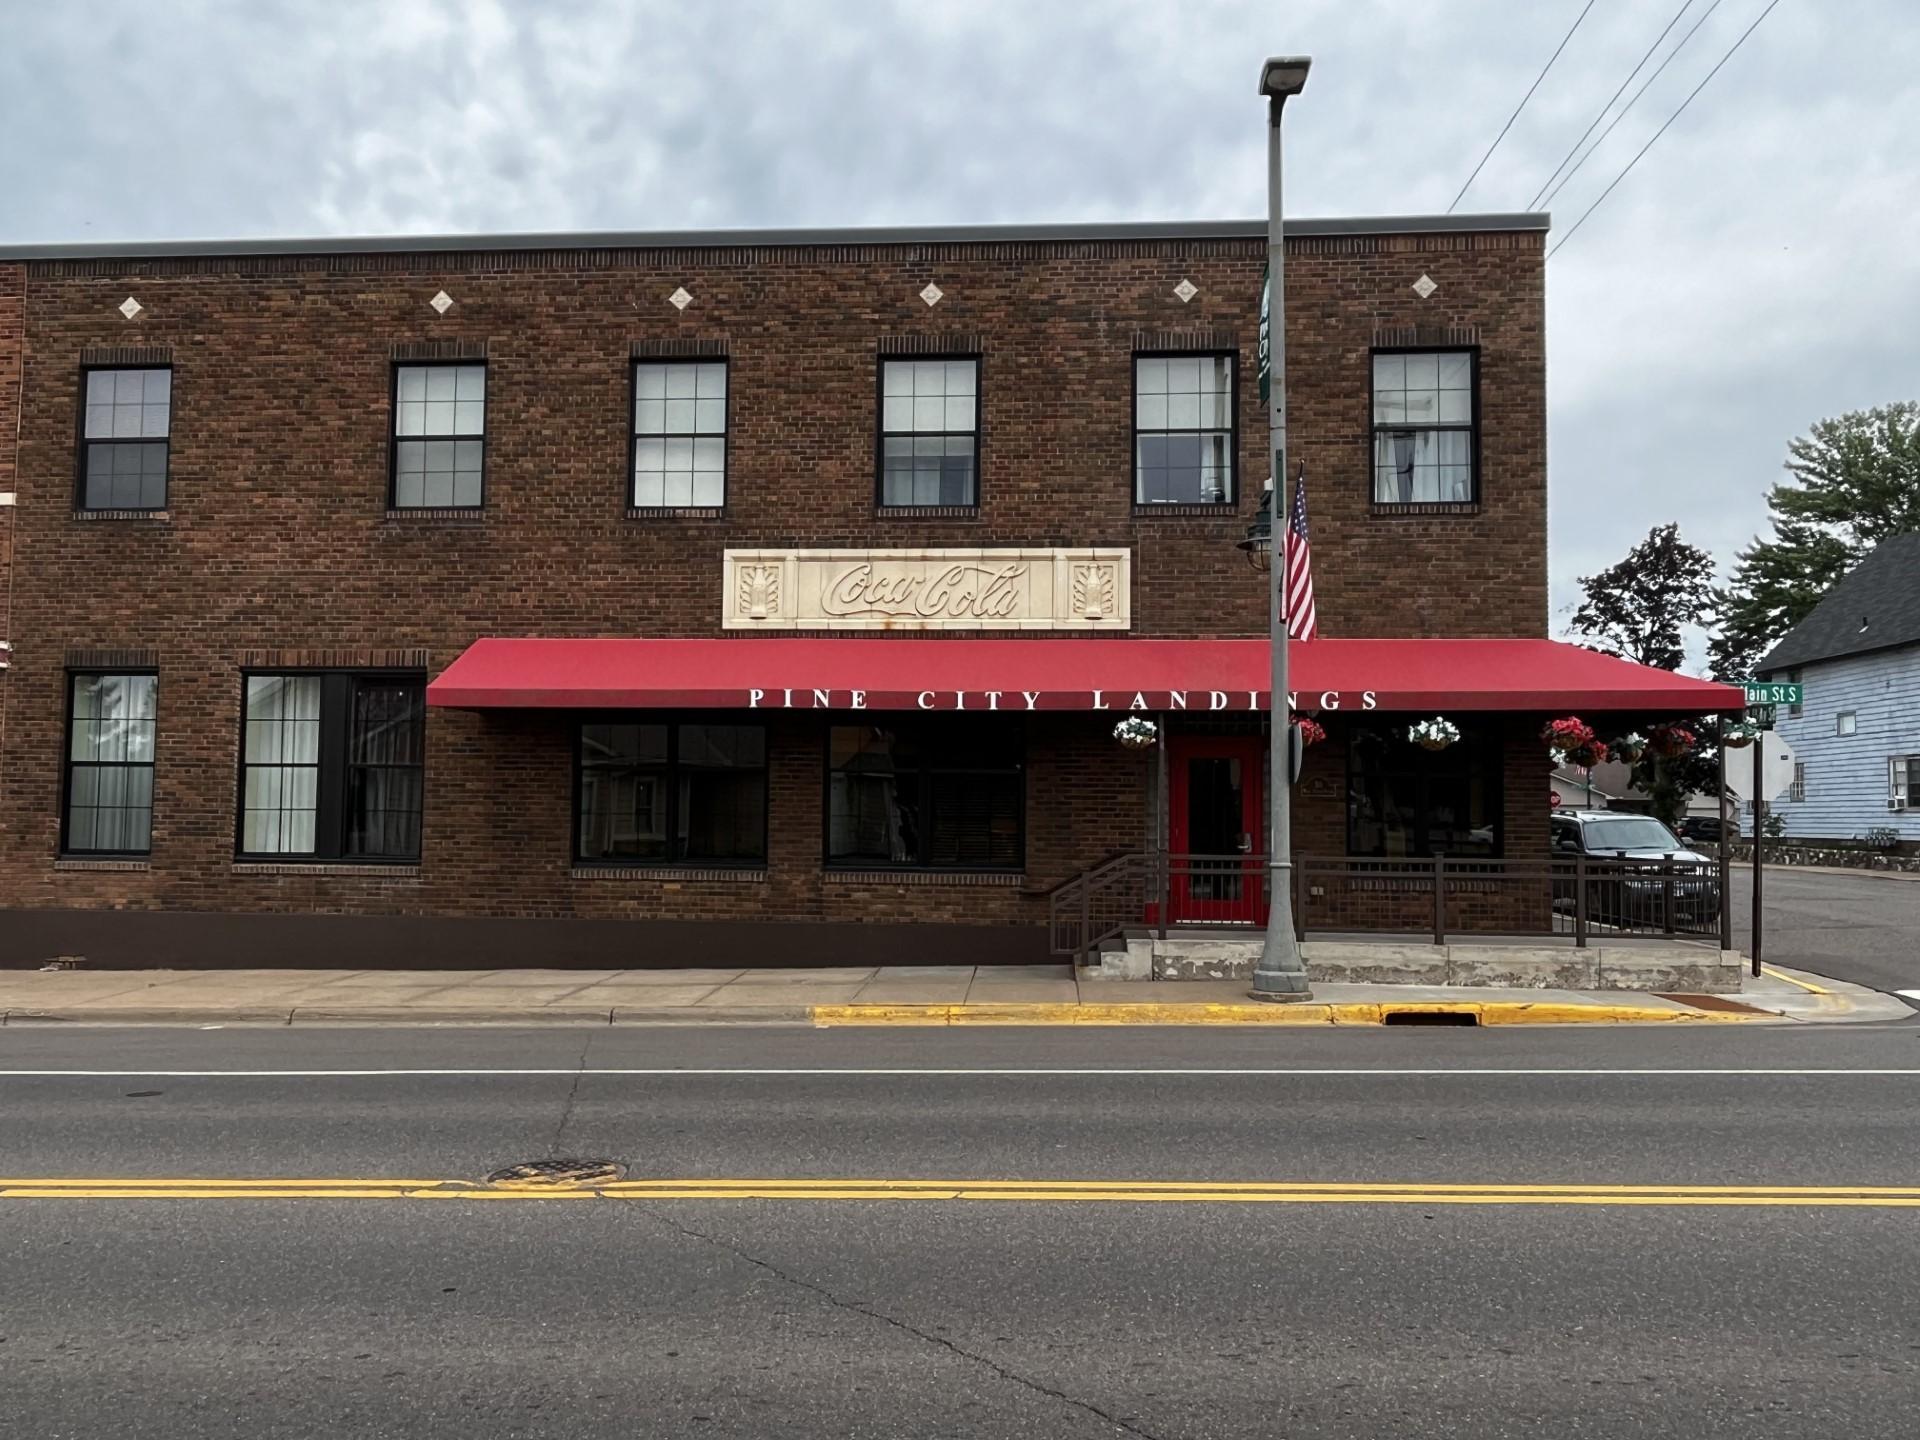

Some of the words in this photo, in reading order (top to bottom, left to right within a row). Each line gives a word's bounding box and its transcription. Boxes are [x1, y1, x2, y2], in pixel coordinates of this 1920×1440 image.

[749, 689, 867, 709] PINE
[917, 690, 1040, 710] CITY
[1092, 690, 1377, 710] LANDINGS
[1772, 686, 1785, 702] St
[1788, 686, 1796, 702] S
